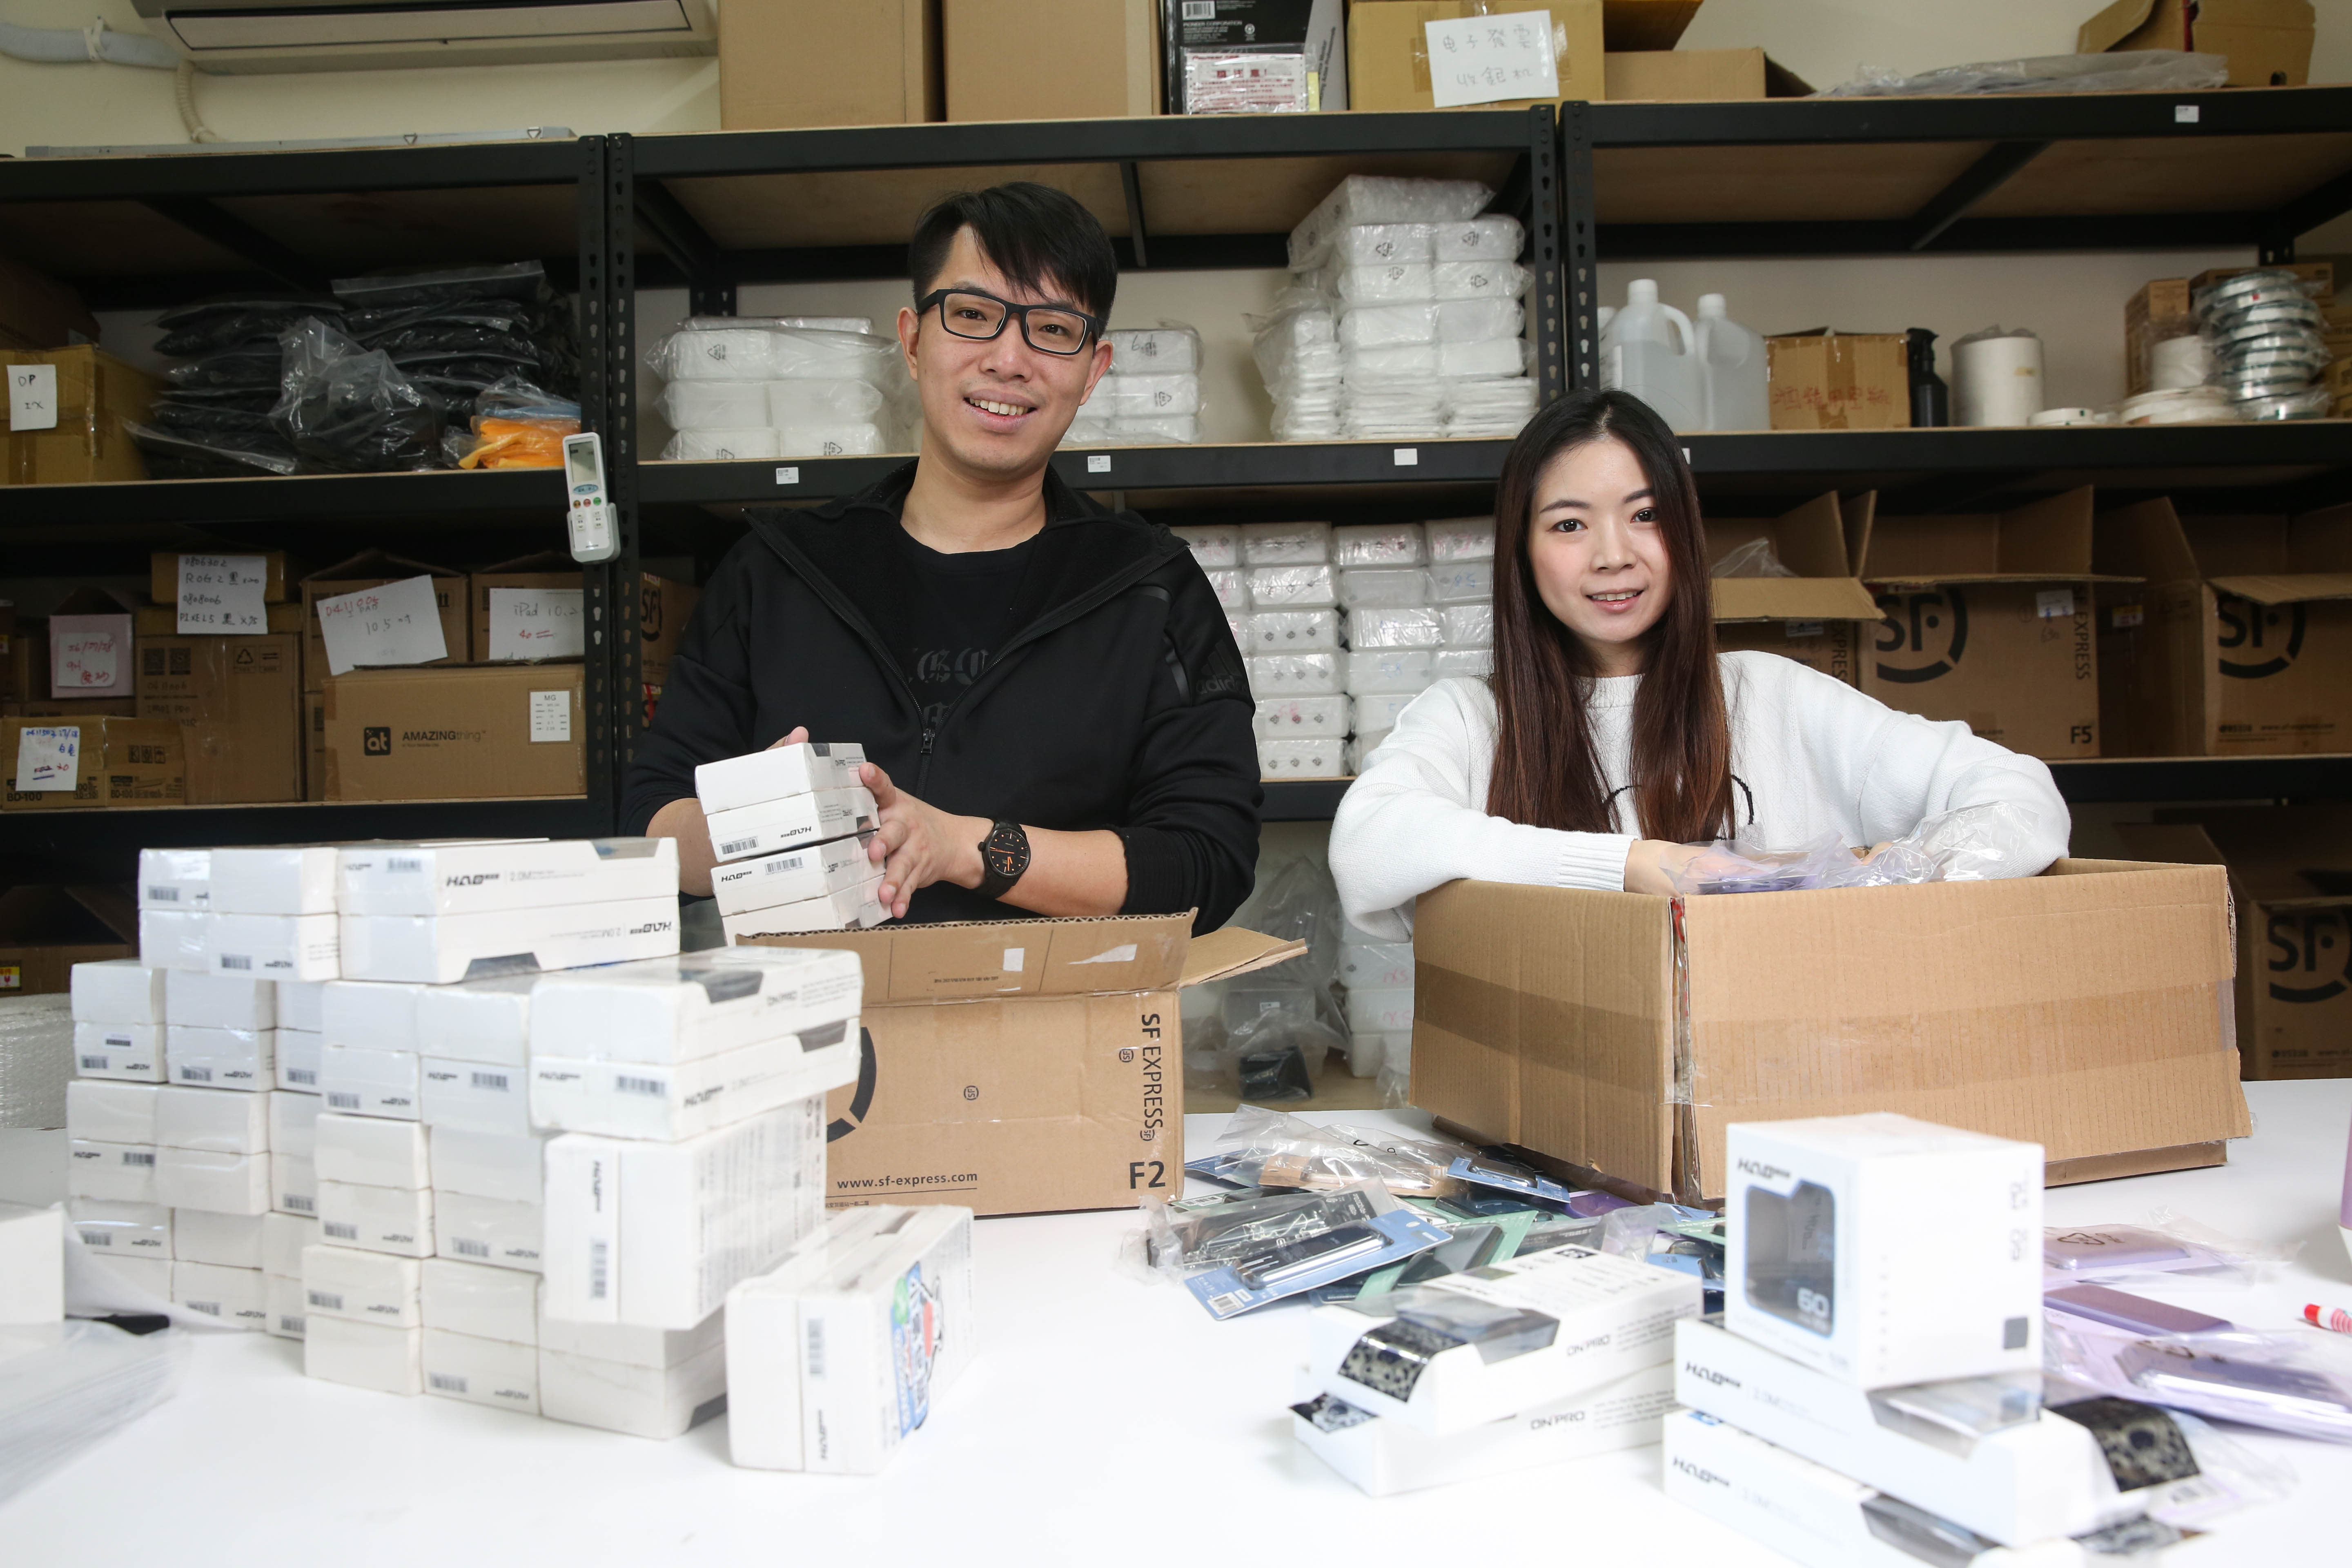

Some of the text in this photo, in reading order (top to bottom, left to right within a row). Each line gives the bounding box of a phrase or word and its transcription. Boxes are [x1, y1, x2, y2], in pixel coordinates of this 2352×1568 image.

[514, 602, 538, 617] iPad
[2074, 611, 2091, 679] EXPRESS
[2071, 726, 2092, 744] F5
[7, 793, 42, 802] BD-100
[1142, 1013, 1163, 1129] SF EXPRESS
[837, 1173, 978, 1189] www.sf-express.com
[1129, 1160, 1165, 1189] F2
[1796, 1287, 1829, 1319] 60
